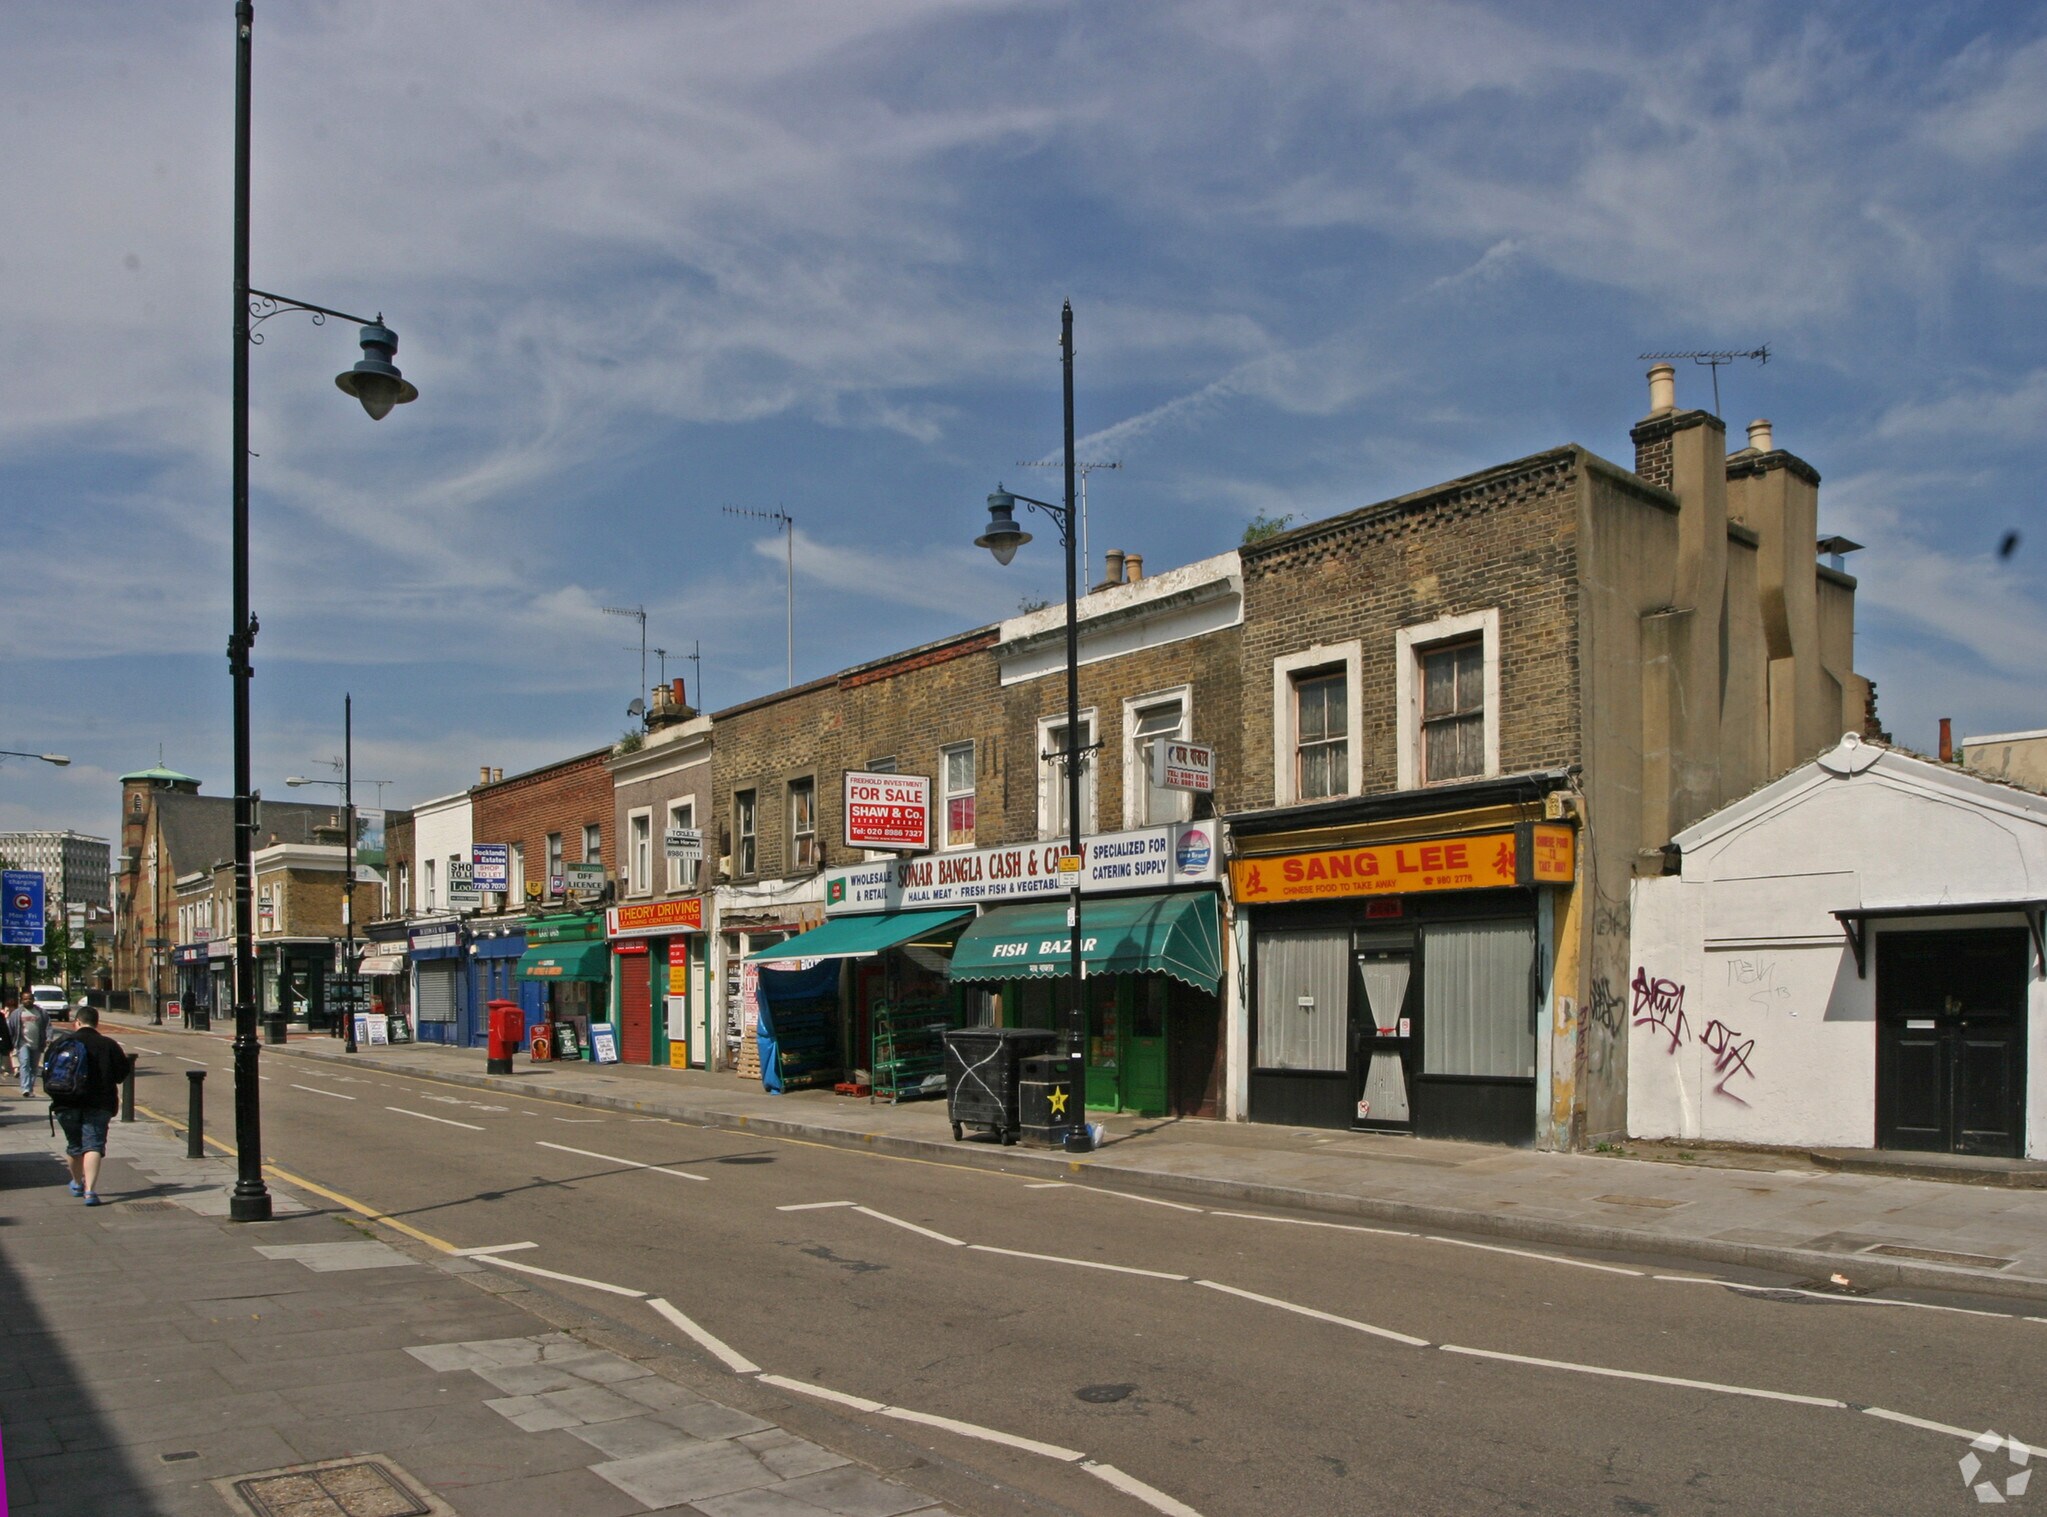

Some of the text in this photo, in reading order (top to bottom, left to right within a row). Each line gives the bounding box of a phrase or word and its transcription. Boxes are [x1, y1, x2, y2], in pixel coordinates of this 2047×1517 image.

[850, 777, 923, 788] FREEHOLD INVESTMENT
[851, 786, 923, 804] FOR SALE
[852, 806, 923, 820] SHAW & Co.
[852, 827, 866, 835] Tel:
[1093, 838, 1166, 859] SPECIALIZED FOR
[451, 863, 472, 871] SHO
[898, 842, 1088, 888] SONAR BANGLA CASH & CAY
[1092, 863, 1131, 880] CATERING
[1135, 859, 1167, 876] SUPPLY
[1283, 844, 1469, 882] SANG LEE
[4, 872, 42, 880] Congestion
[850, 871, 893, 886] WHOLESALE
[1437, 876, 1451, 885] 980
[856, 888, 888, 901] & RETAIL
[908, 891, 930, 902] HALAL
[933, 888, 952, 899] MEAT
[961, 886, 985, 897] FRESH
[989, 883, 1006, 895] FISH
[1009, 882, 1015, 893] &
[1017, 878, 1059, 892] VEGETABL
[1283, 879, 1397, 895] CHINESE FOOD TO TAKE AWAY
[619, 901, 700, 921] THEORY DRIVING
[992, 938, 1097, 957] FISH BAZR
